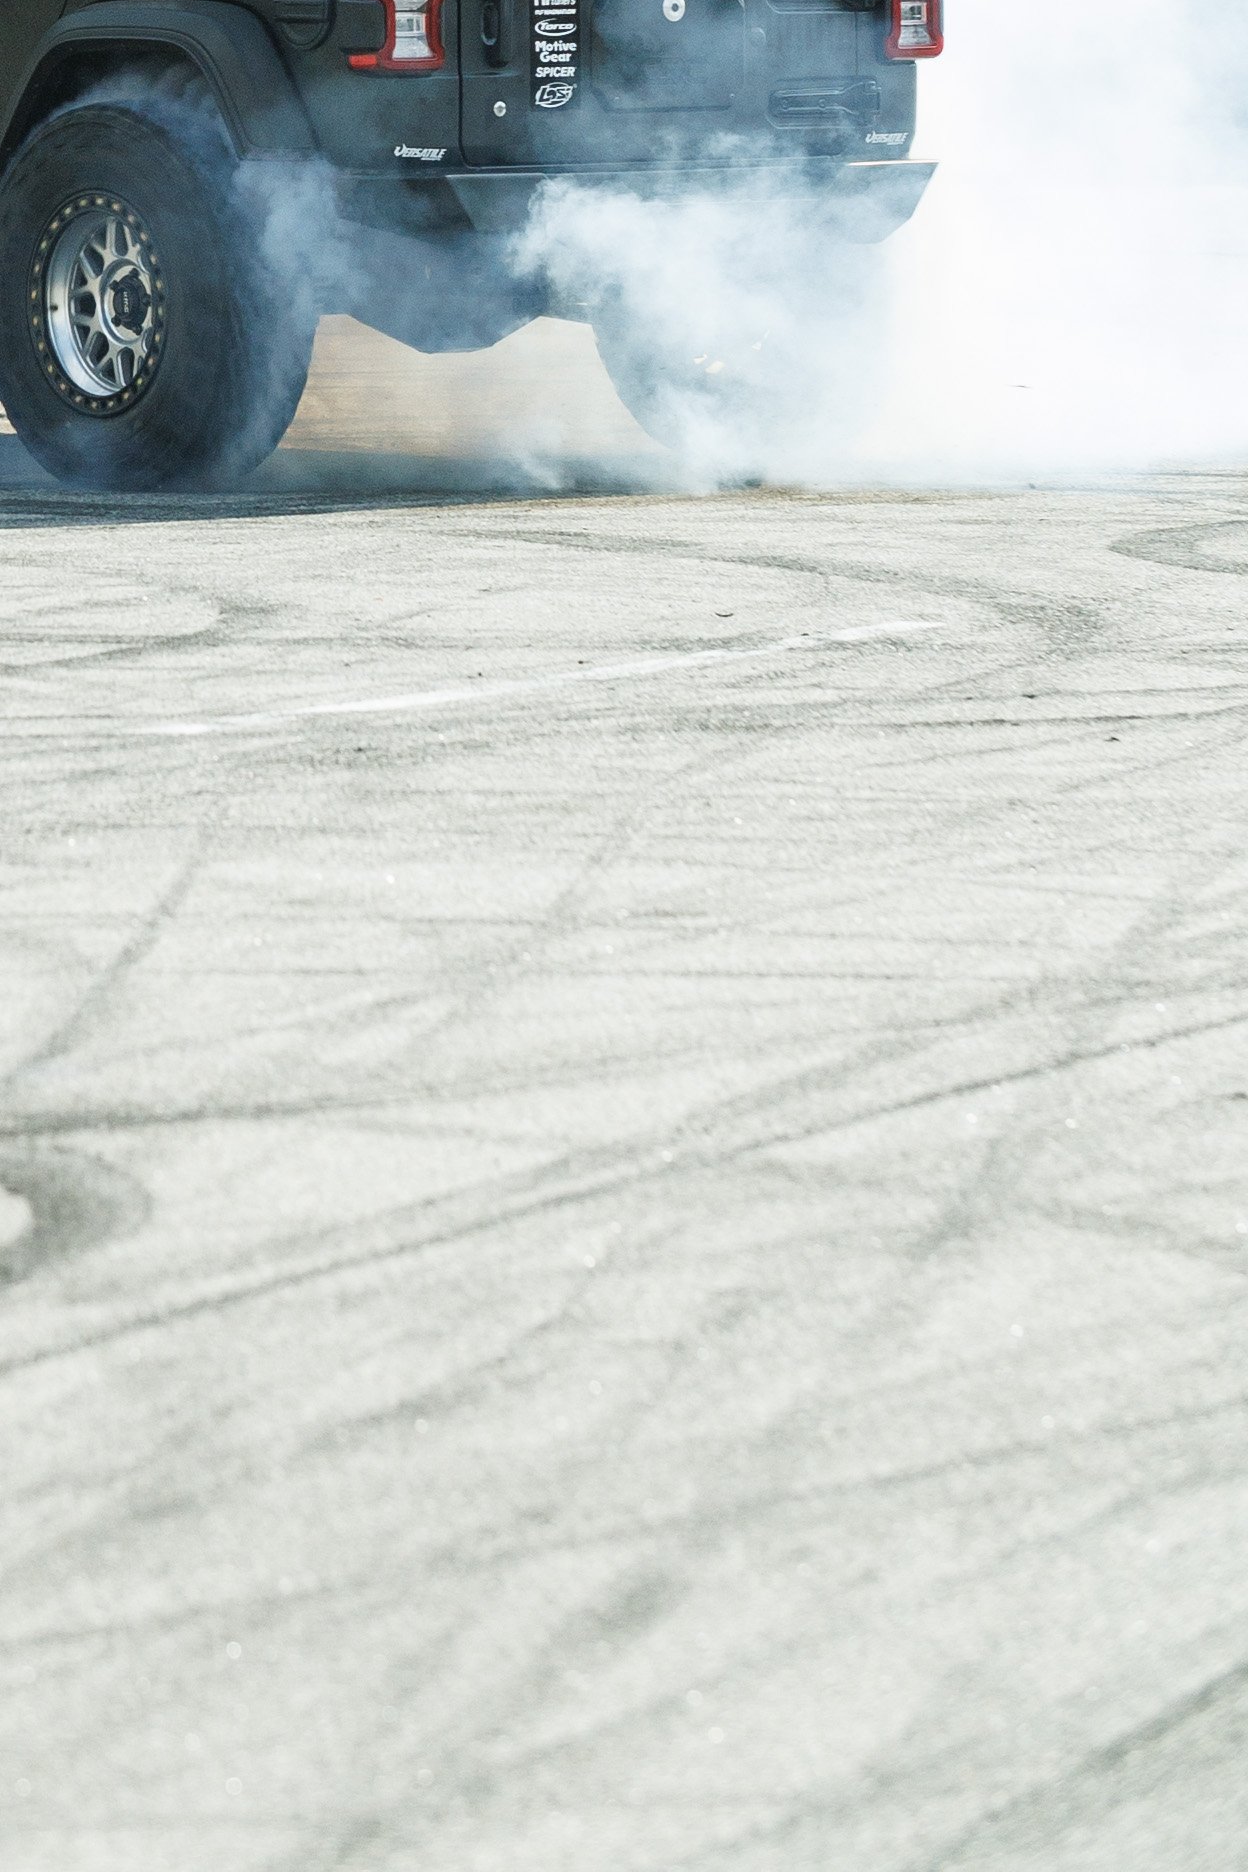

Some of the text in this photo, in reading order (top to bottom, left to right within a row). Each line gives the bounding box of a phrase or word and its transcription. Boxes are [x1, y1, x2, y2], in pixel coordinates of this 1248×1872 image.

[535, 40, 577, 52] Motive
[539, 51, 572, 63] Gear
[535, 67, 575, 77] SPICER
